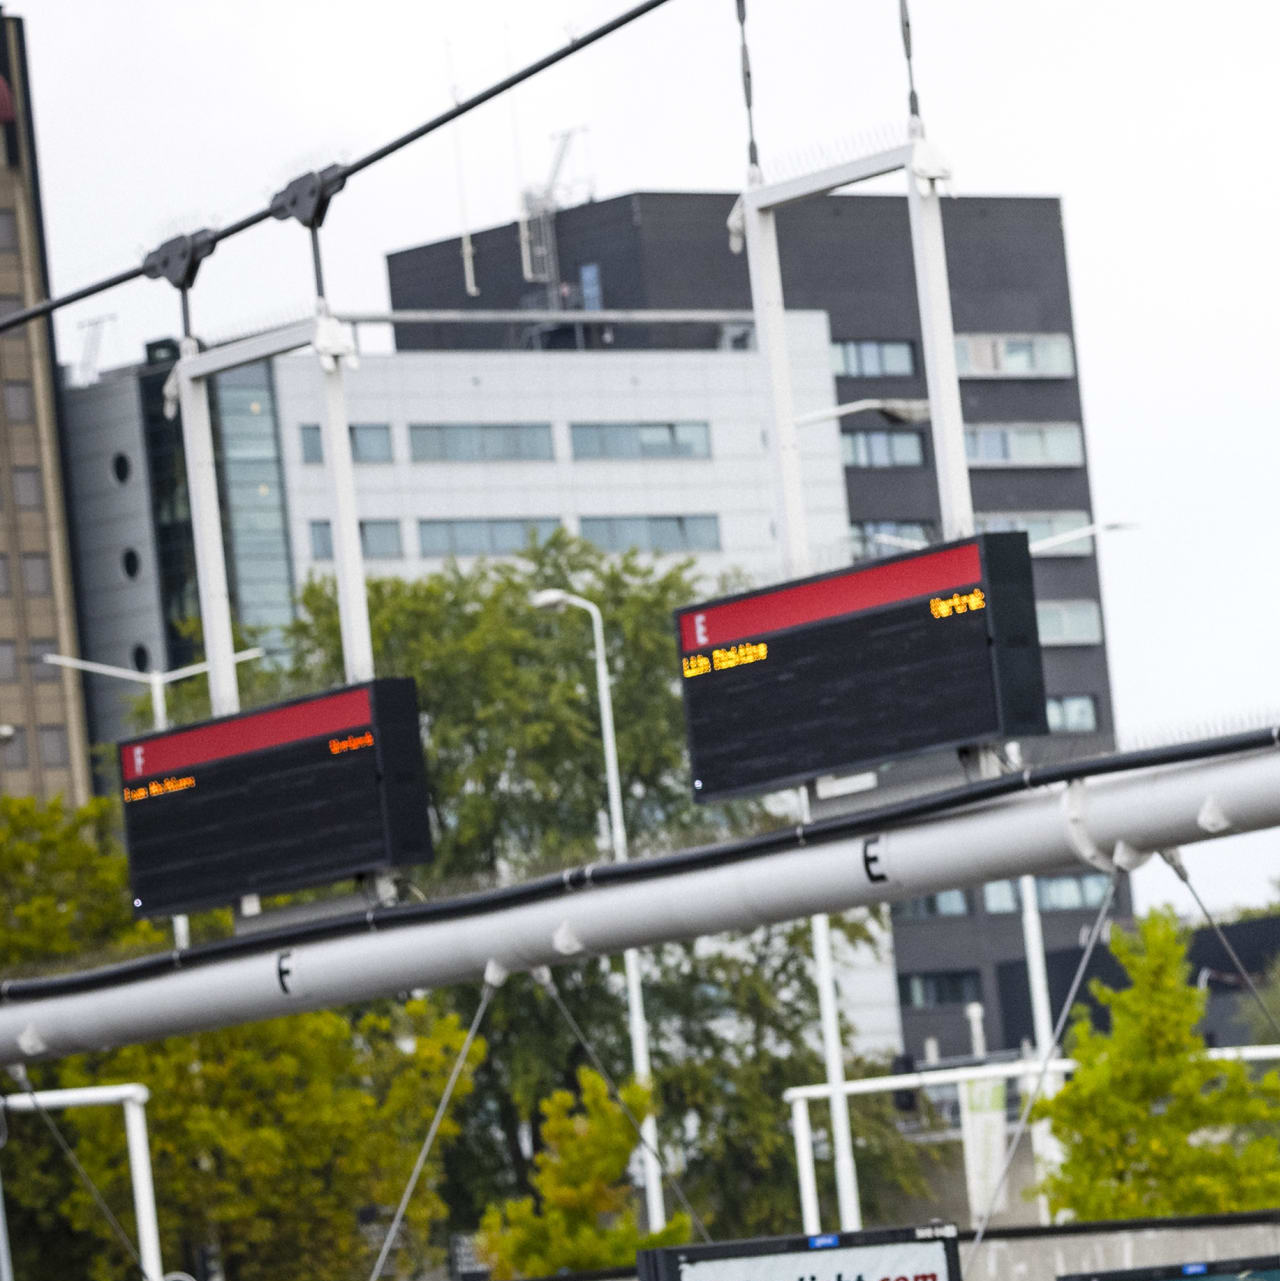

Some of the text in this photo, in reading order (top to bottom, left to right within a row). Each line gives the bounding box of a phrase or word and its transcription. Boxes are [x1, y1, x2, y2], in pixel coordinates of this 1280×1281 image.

[694, 613, 709, 646] E
[862, 836, 888, 883] E
[277, 949, 293, 995] F
